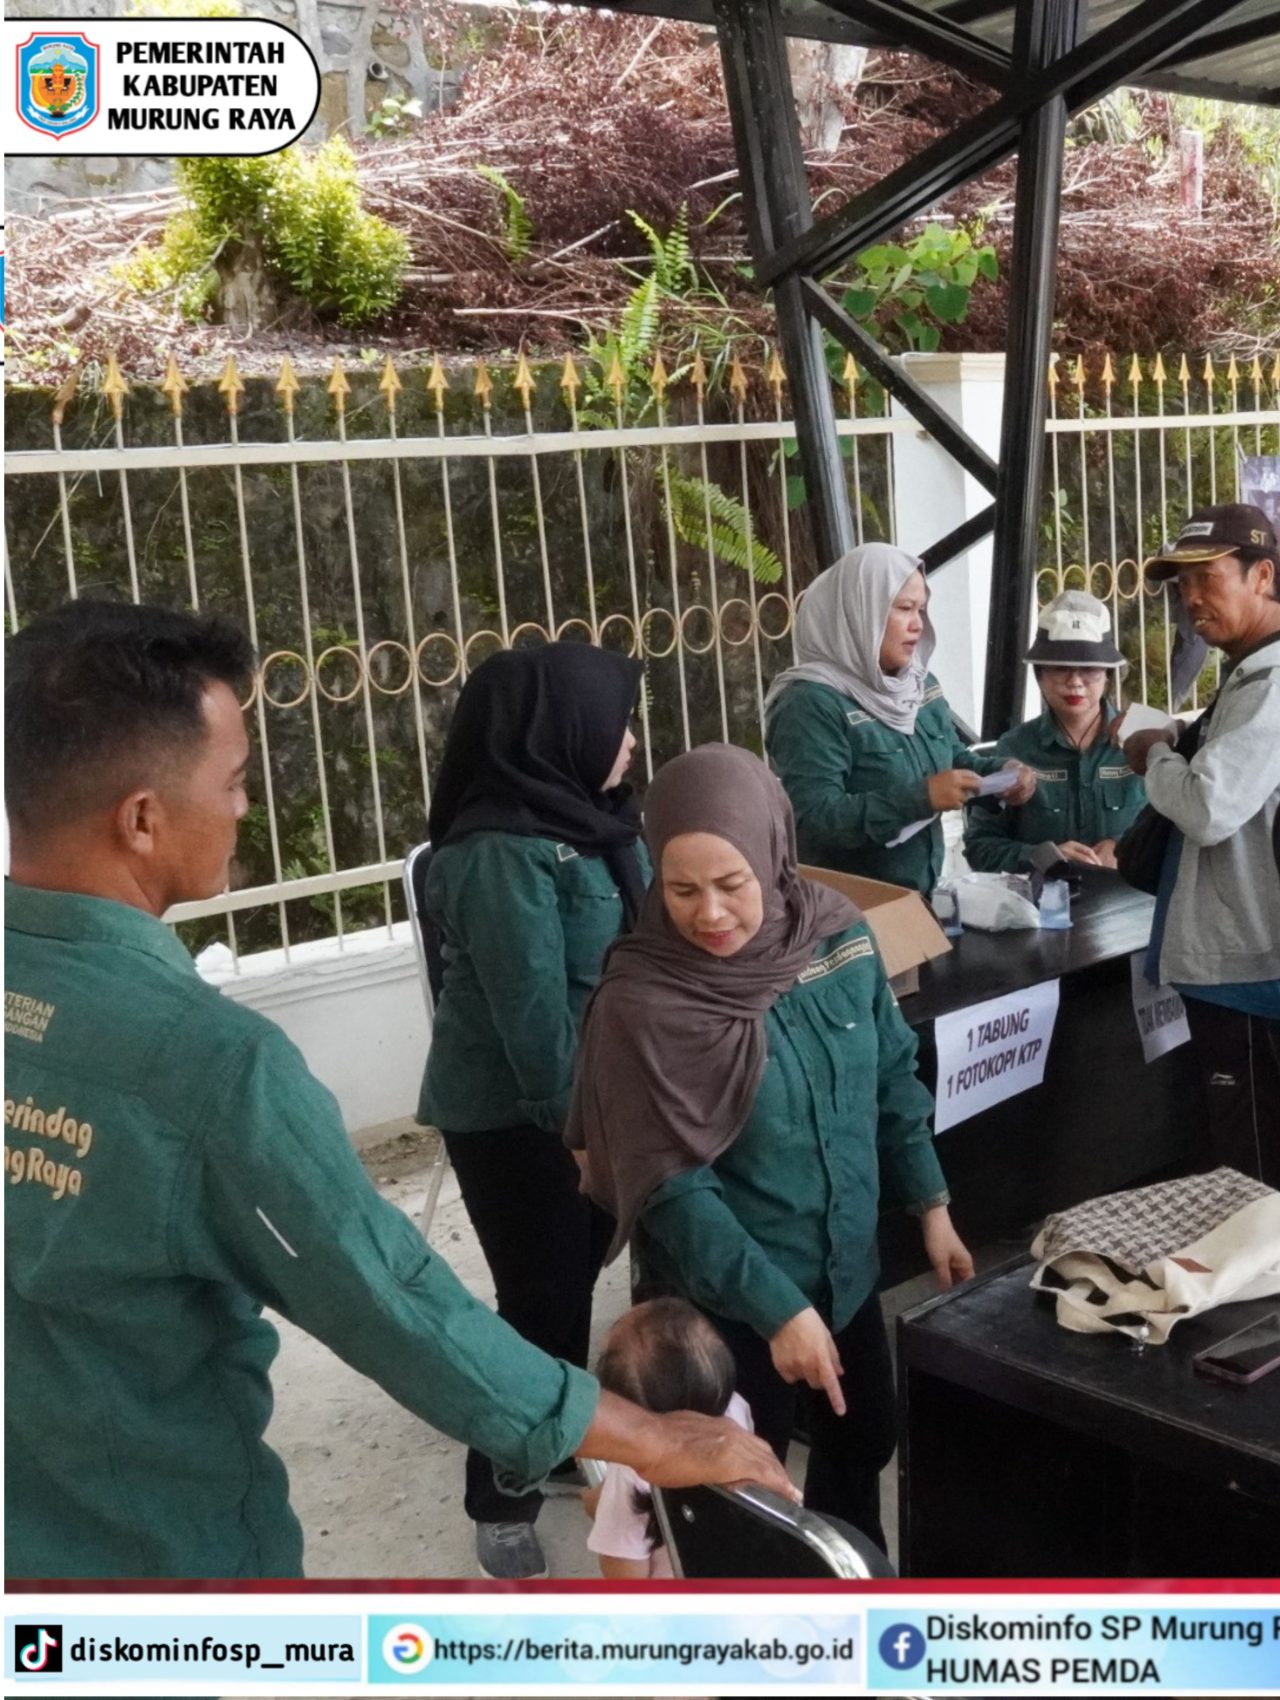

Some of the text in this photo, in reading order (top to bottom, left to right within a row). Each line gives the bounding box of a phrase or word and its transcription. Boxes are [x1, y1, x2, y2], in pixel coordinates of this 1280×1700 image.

[1250, 529, 1267, 546] ST
[967, 1008, 1030, 1053] 1 TABUNG
[947, 1038, 1043, 1099] 1 FOTOKOPI KTP
